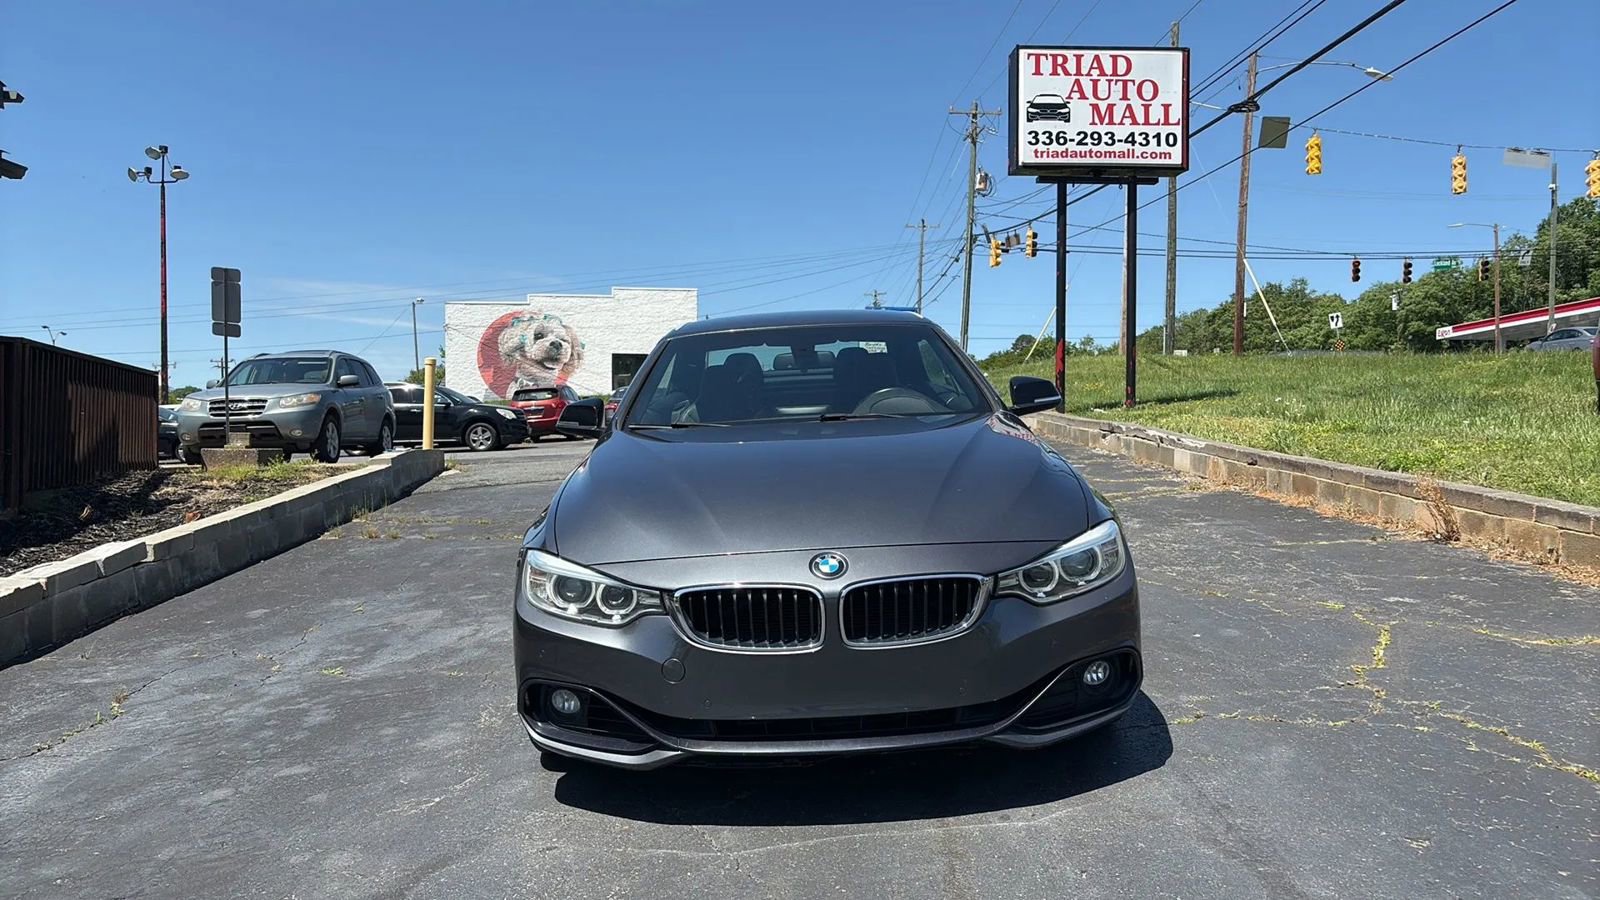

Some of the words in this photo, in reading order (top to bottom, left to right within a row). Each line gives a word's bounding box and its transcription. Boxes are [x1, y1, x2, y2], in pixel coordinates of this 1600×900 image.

[1027, 53, 1132, 77] TRIAD
[1066, 78, 1159, 102] AUTO
[1088, 103, 1181, 126] MALL
[1027, 130, 1178, 147] 336-293-4310
[1033, 148, 1172, 160] triadautomall.com
